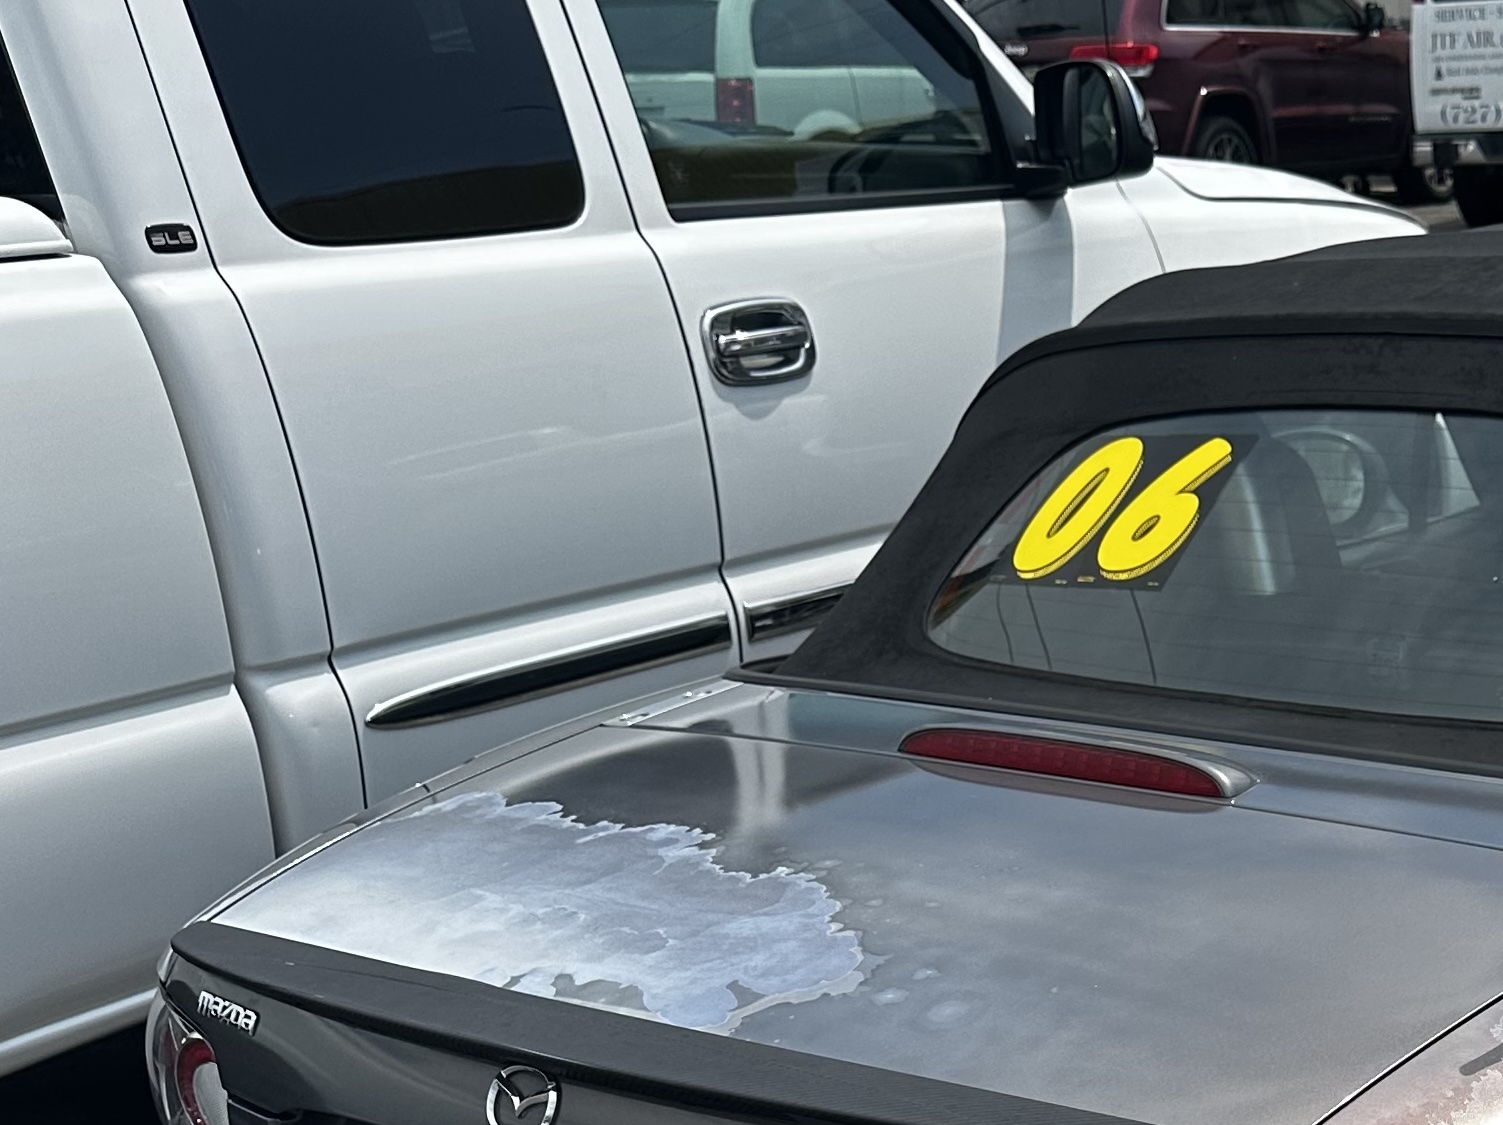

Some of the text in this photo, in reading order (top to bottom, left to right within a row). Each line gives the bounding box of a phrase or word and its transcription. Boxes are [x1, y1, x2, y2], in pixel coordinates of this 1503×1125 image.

[1462, 30, 1496, 49] AIR
[1440, 102, 1502, 124] (727)
[150, 231, 194, 246] SLE
[1012, 436, 1233, 581] 06
[197, 990, 257, 1033] mazda
